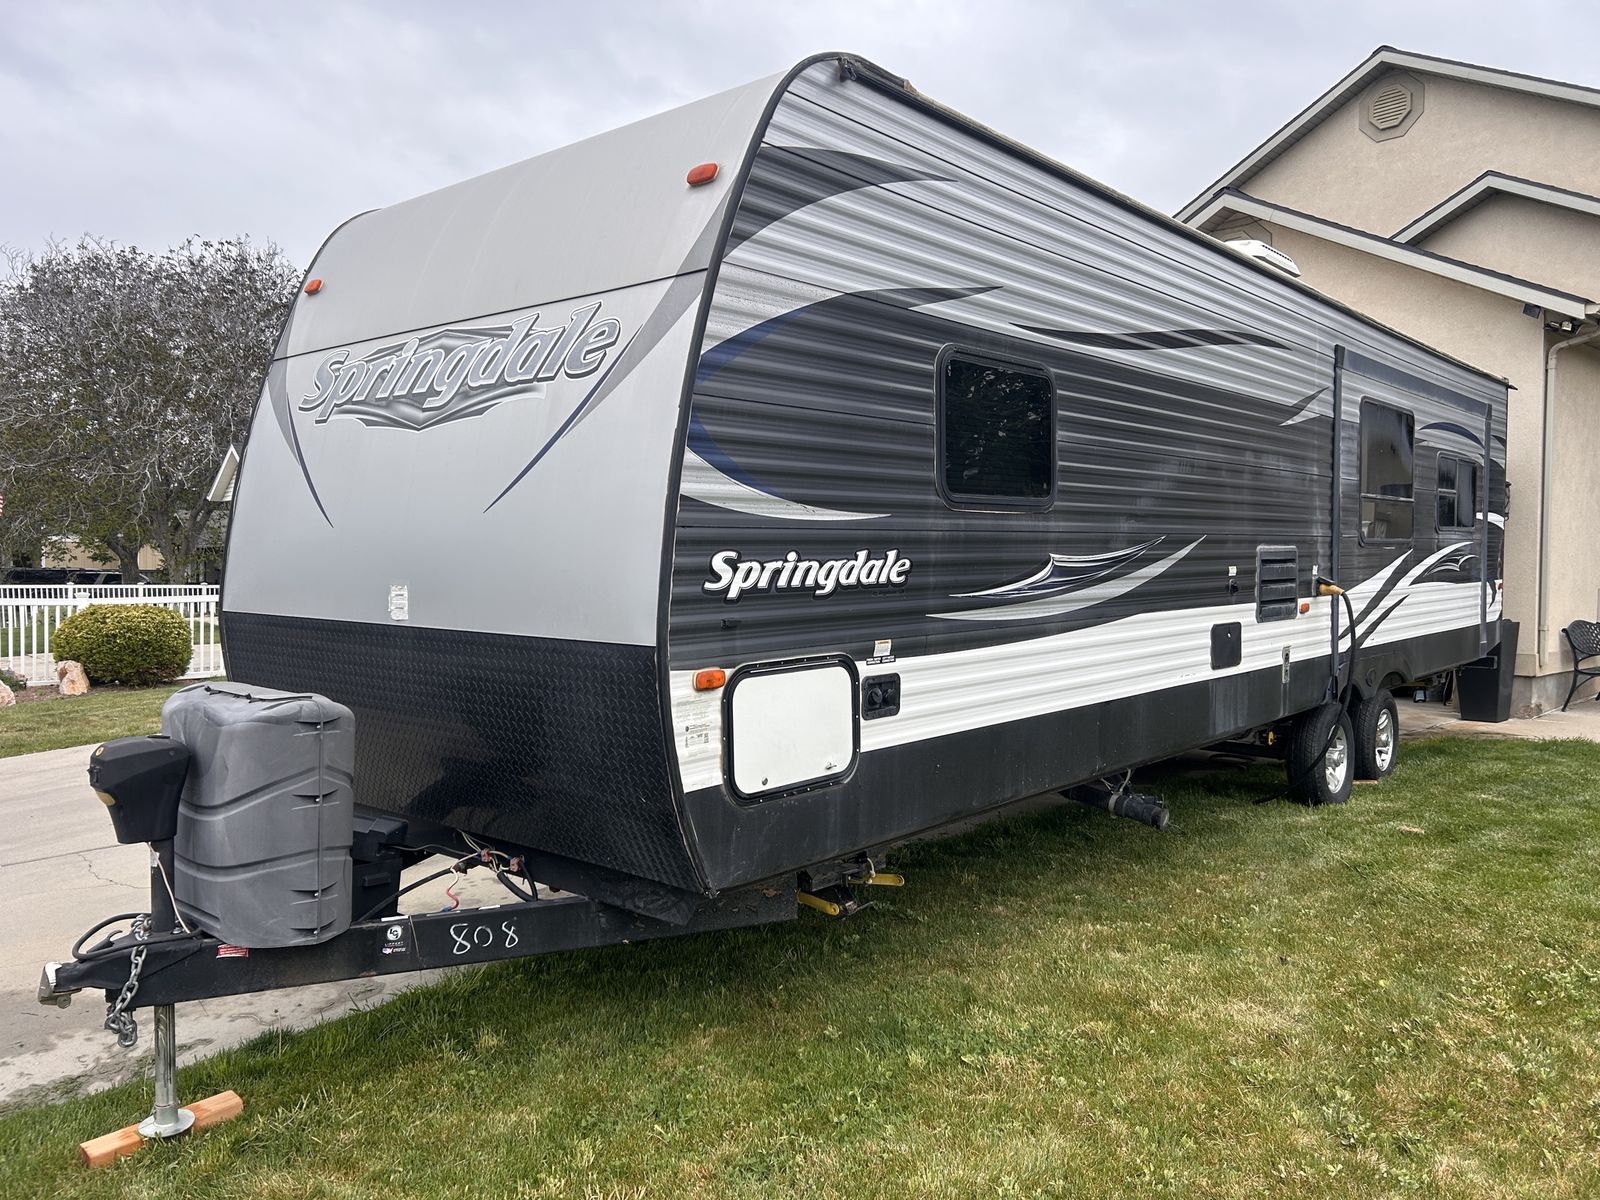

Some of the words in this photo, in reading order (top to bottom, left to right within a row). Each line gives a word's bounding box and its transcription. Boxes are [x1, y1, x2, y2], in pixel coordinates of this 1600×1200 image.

[298, 301, 621, 425] Springdale
[703, 549, 911, 601] Springdale
[449, 921, 519, 955] 808
